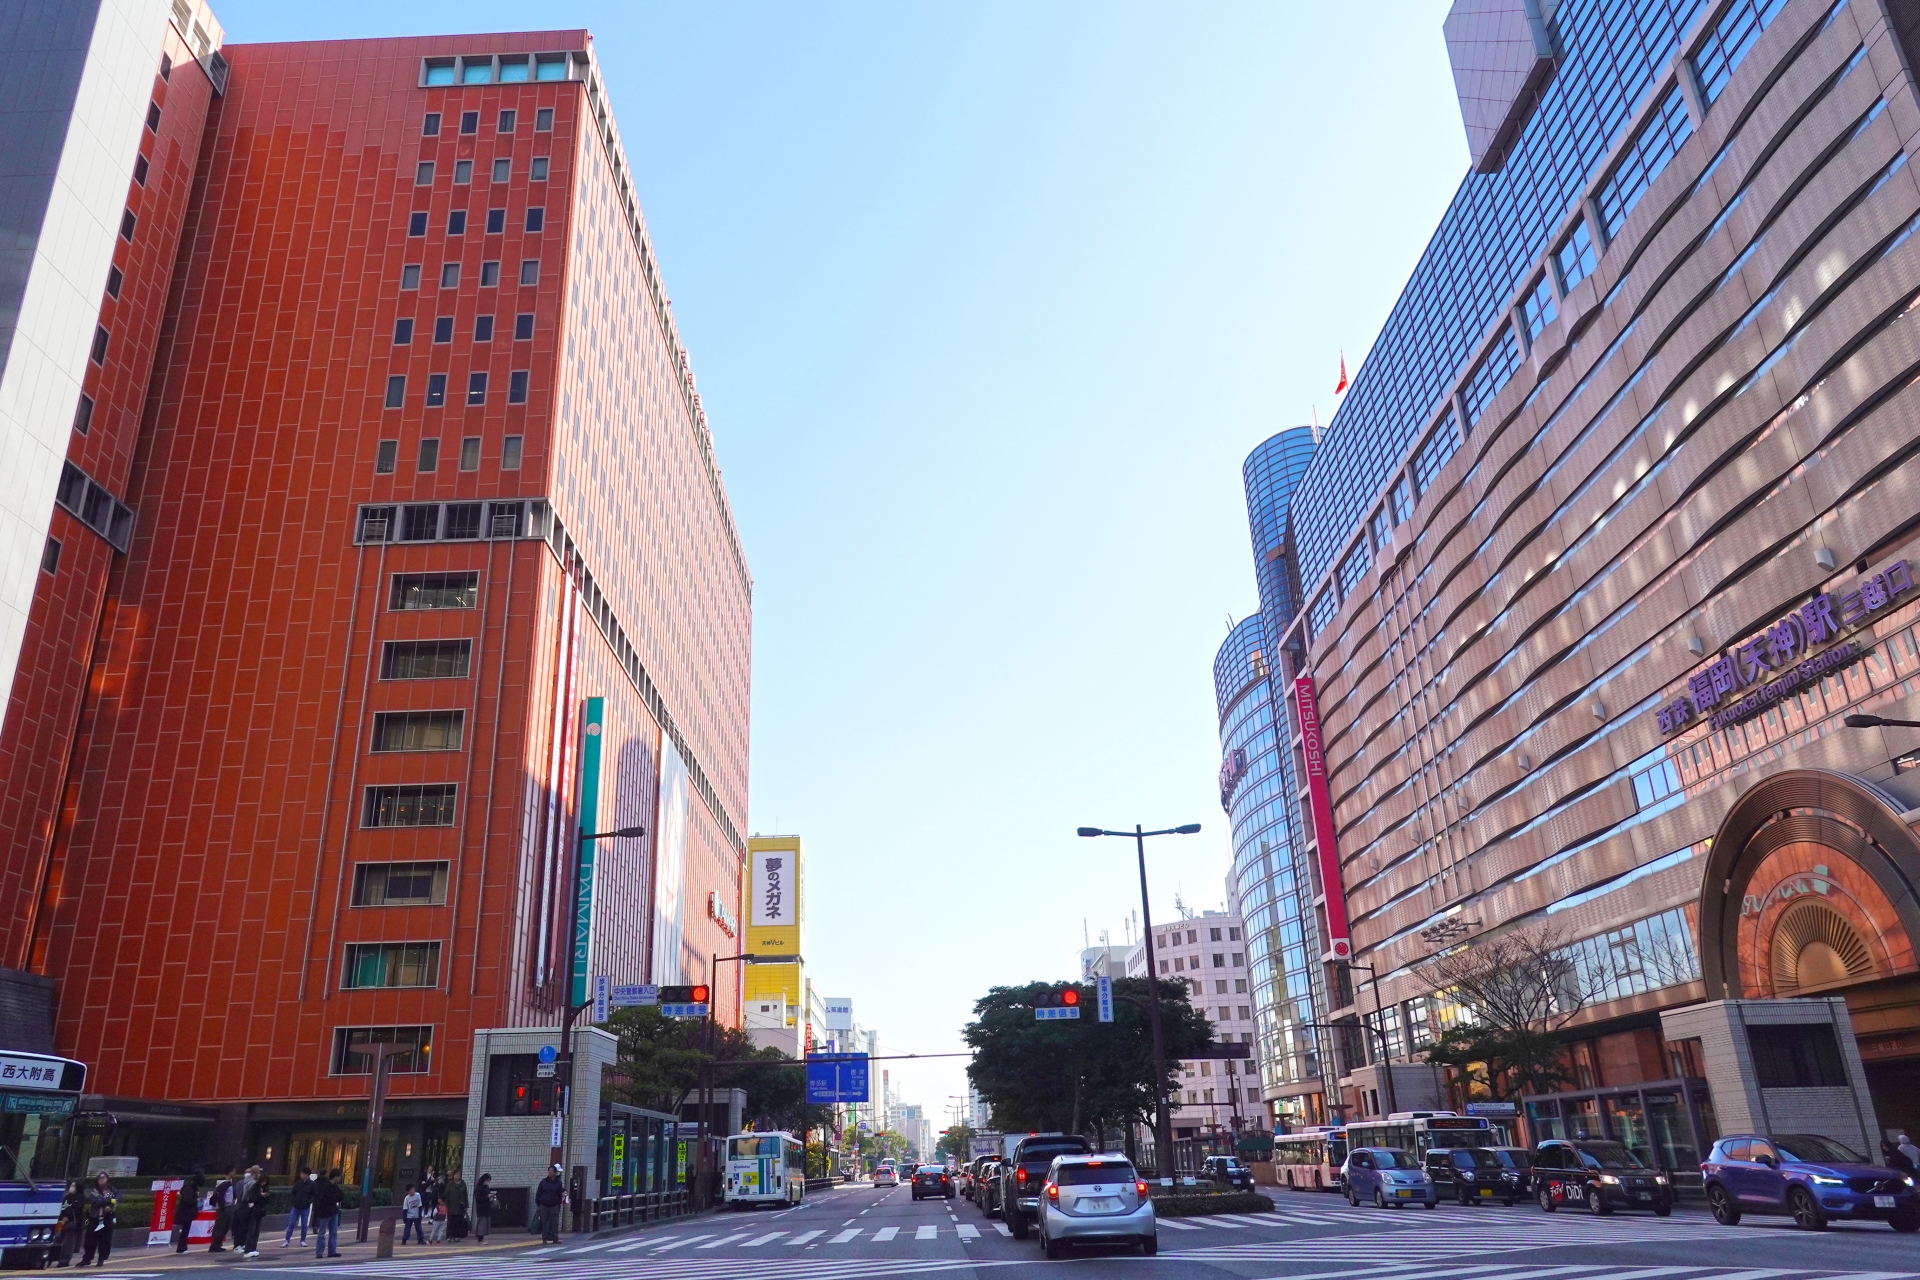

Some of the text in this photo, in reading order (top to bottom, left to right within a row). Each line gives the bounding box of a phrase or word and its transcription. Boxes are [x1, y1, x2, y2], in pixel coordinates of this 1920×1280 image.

[1655, 559, 1915, 735] 西鉄 福岡(天神)駅 三越口
[1801, 644, 1852, 680] Station
[1299, 684, 1323, 777] MITSUKOSHI
[765, 857, 783, 919] 夢のメガネ
[597, 978, 606, 1021] 歩車分離信号
[614, 987, 655, 996] 中央警察署入口
[1101, 979, 1109, 1020] 歩車分離信号
[663, 1005, 707, 1015] 時差信号
[1036, 1008, 1078, 1018] 時差信号
[2, 1064, 56, 1082] 西大附高
[1565, 1184, 1584, 1200] DiDi
